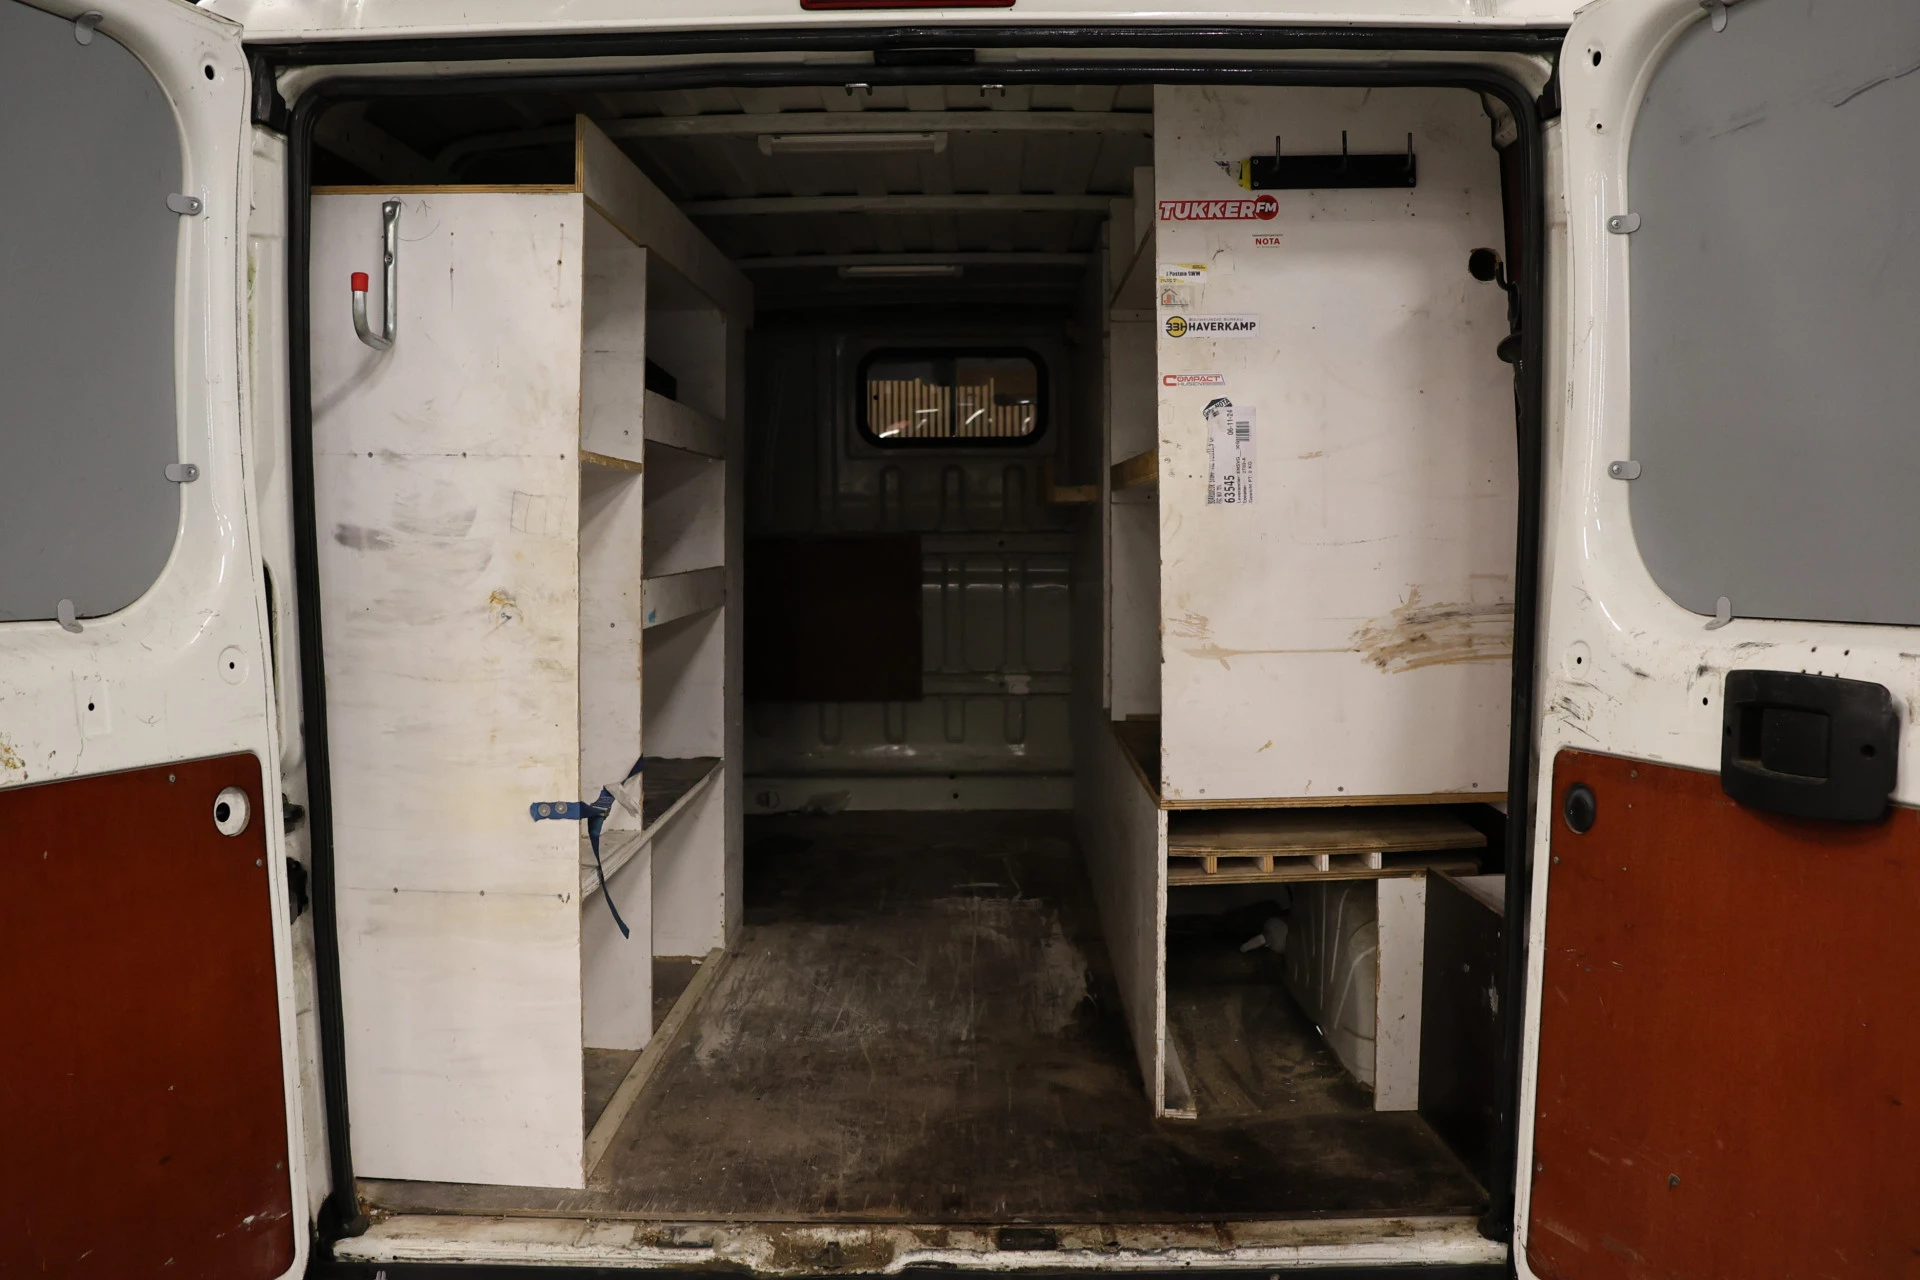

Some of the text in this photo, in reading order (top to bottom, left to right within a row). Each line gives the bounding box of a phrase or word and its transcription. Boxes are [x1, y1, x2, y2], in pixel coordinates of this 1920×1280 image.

[1161, 202, 1277, 219] TUKKER FM
[1255, 237, 1280, 245] NOTA
[1188, 322, 1256, 331] HAVERKAMP
[1163, 374, 1221, 387] COMPACT
[1224, 475, 1235, 504] 63545
